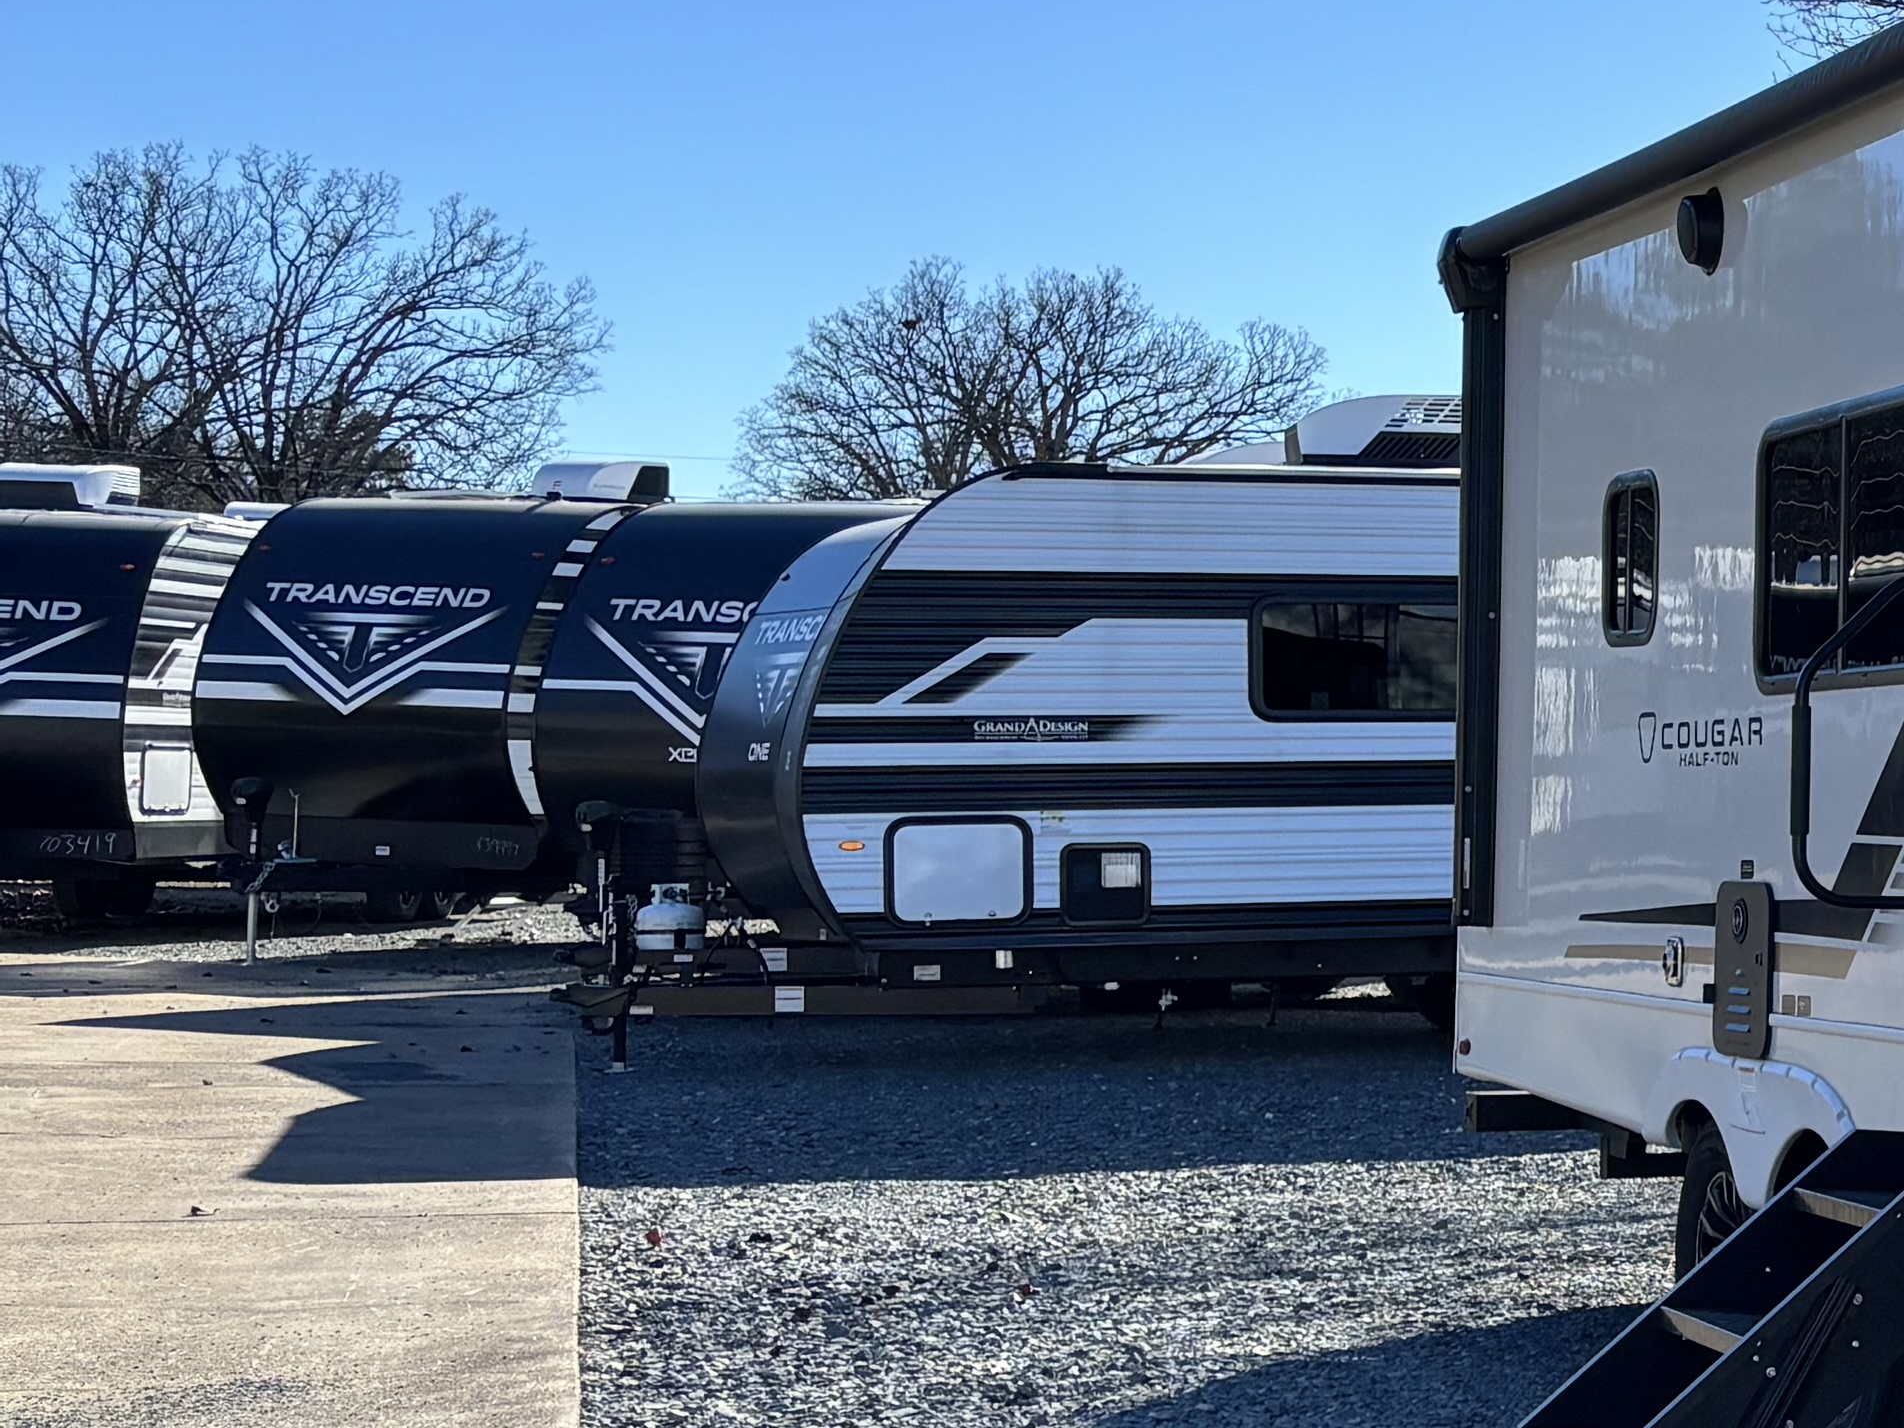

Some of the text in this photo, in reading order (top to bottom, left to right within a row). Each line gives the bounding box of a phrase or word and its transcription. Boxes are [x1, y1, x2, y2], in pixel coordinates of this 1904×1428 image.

[266, 582, 491, 608] TRANSCEND
[754, 615, 827, 645] TRANSC
[973, 720, 1088, 732] GRAND DESIGN
[1661, 717, 1763, 750] COUGAR
[40, 833, 117, 854] 103419
